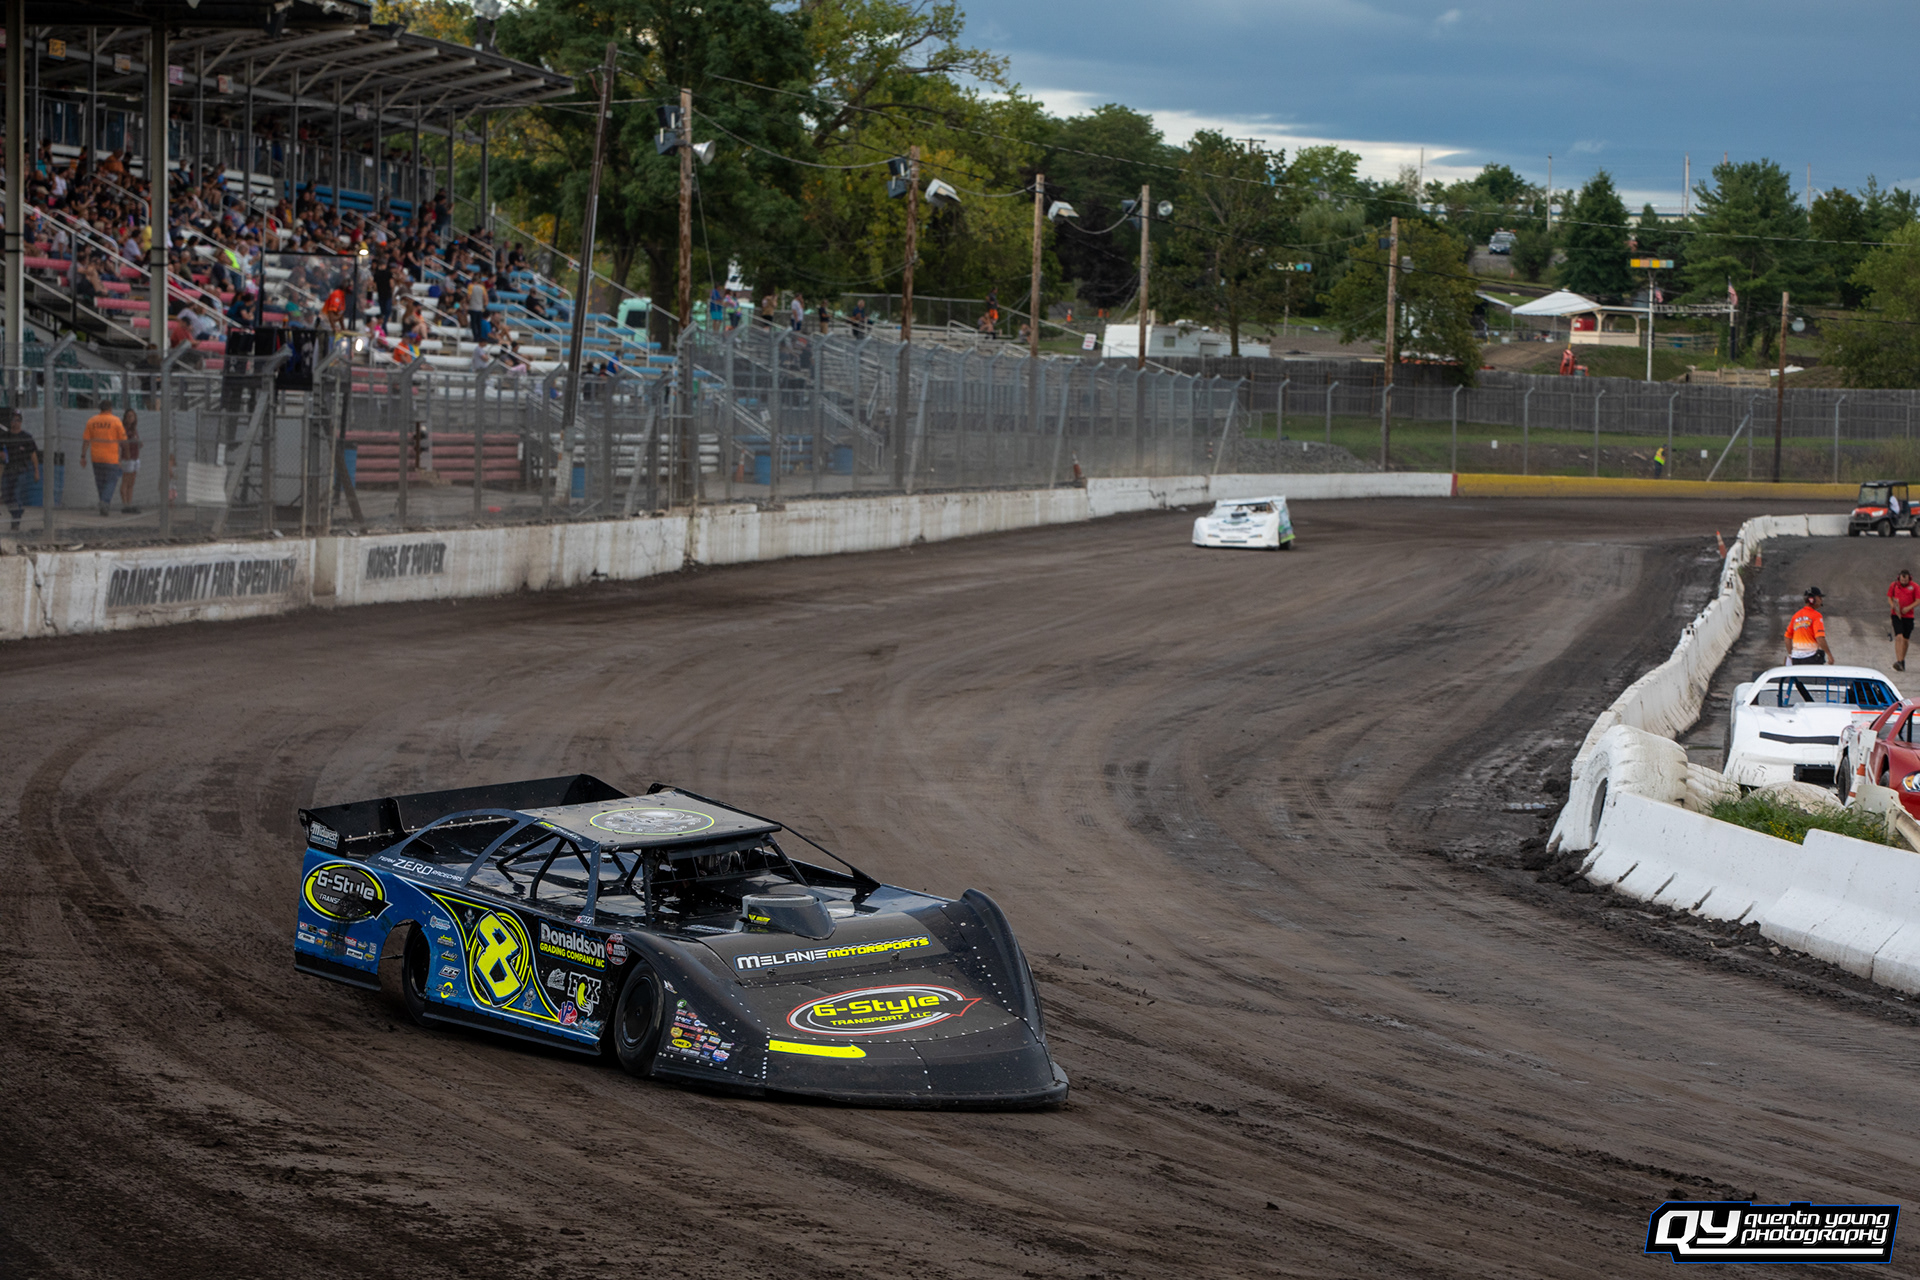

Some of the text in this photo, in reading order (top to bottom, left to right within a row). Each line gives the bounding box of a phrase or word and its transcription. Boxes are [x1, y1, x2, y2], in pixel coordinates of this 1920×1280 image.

[366, 543, 447, 580] HOUSE OF POWER
[107, 558, 298, 608] ORANGE COUNTY FAIR SPEEDWAY
[392, 858, 433, 875] ZERO
[317, 869, 375, 901] G-Style
[477, 914, 520, 998] 8
[540, 922, 605, 959] Donaldson
[540, 942, 566, 957] GRADING
[566, 950, 595, 966] COMPANY
[567, 972, 602, 1005] FOX
[560, 1001, 575, 1024] VP
[813, 995, 941, 1017] G-Style
[910, 1011, 932, 1019] LLC
